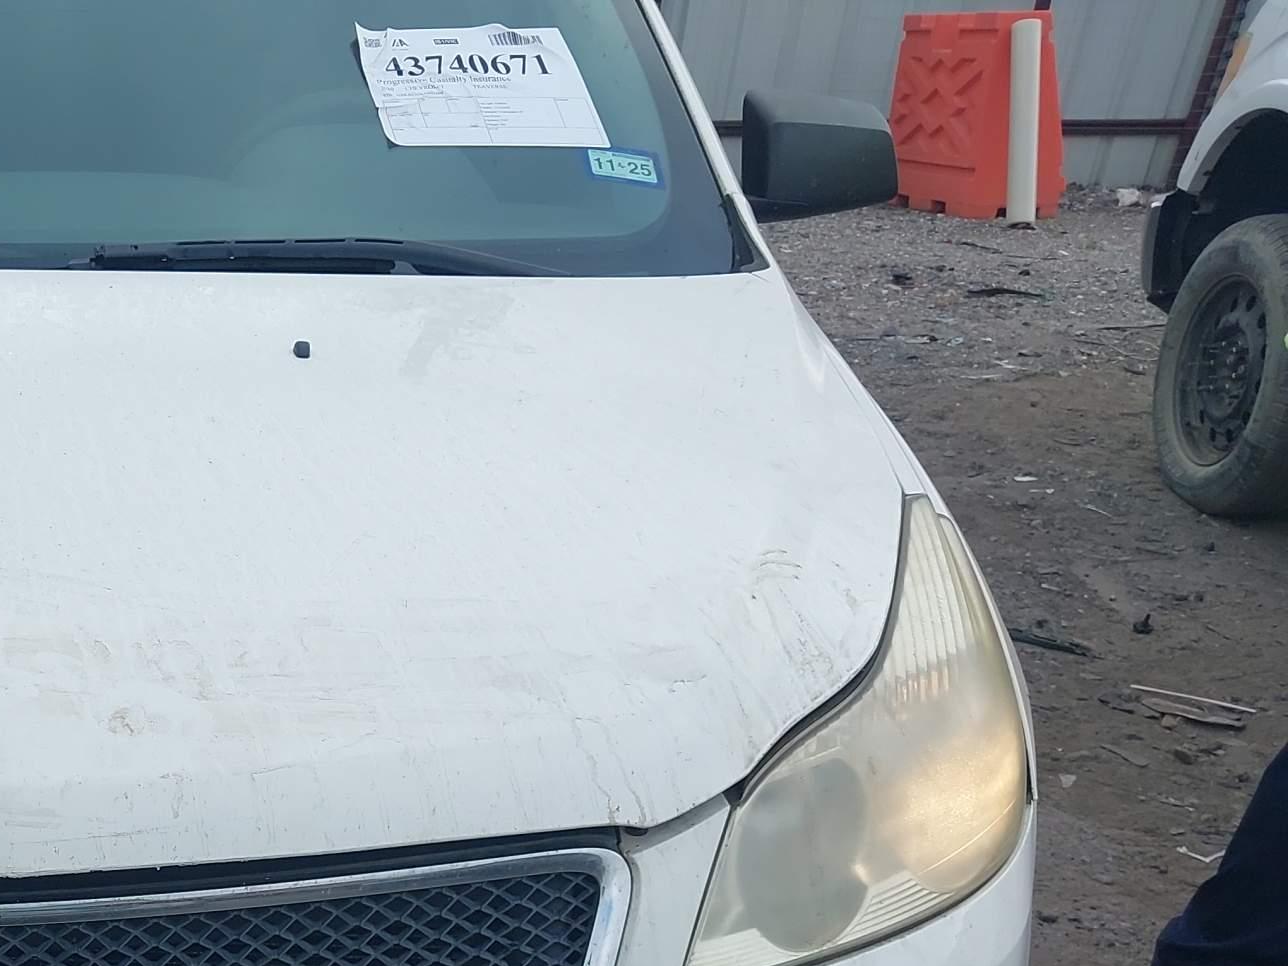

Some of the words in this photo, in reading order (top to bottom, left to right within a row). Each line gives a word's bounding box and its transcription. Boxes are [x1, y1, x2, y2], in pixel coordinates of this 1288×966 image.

[385, 54, 552, 77] 43740671
[593, 157, 615, 171] 11
[627, 162, 652, 176] 25
